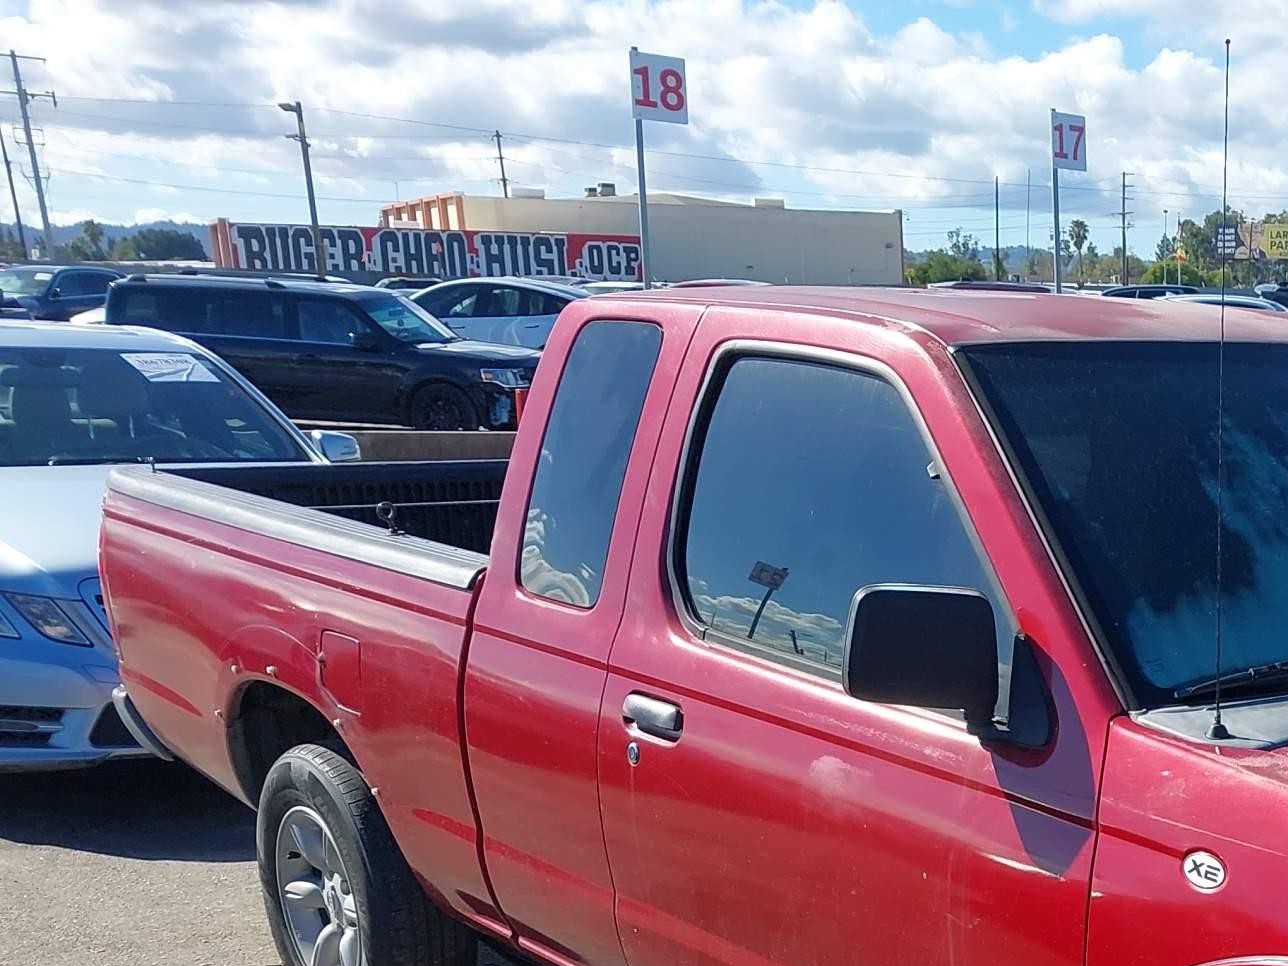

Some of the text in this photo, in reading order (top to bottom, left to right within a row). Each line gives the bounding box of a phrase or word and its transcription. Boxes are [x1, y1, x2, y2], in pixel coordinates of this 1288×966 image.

[633, 65, 685, 112] 18
[1054, 123, 1085, 161] 17
[1187, 858, 1221, 883] XE
